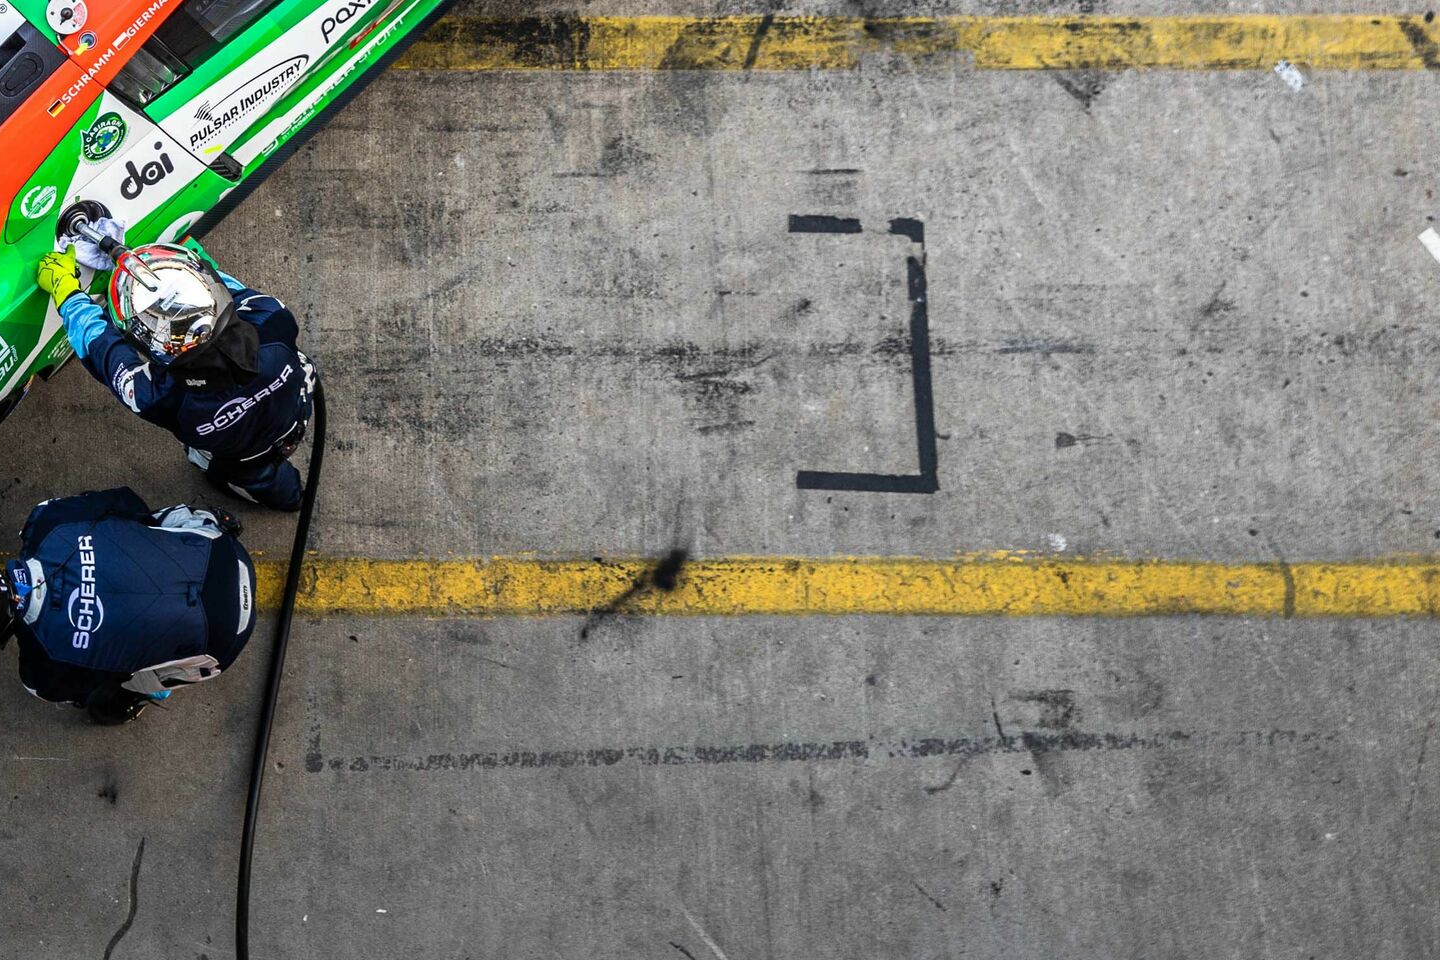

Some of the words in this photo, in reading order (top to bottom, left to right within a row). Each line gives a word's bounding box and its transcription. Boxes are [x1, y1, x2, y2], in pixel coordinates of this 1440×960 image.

[61, 46, 116, 109] SCHRAMM
[189, 103, 240, 149] PULSAR
[238, 57, 305, 116] INDUSTRY
[120, 141, 176, 202] dai
[196, 364, 294, 437] SCHERER
[71, 534, 100, 650] SCHERER
